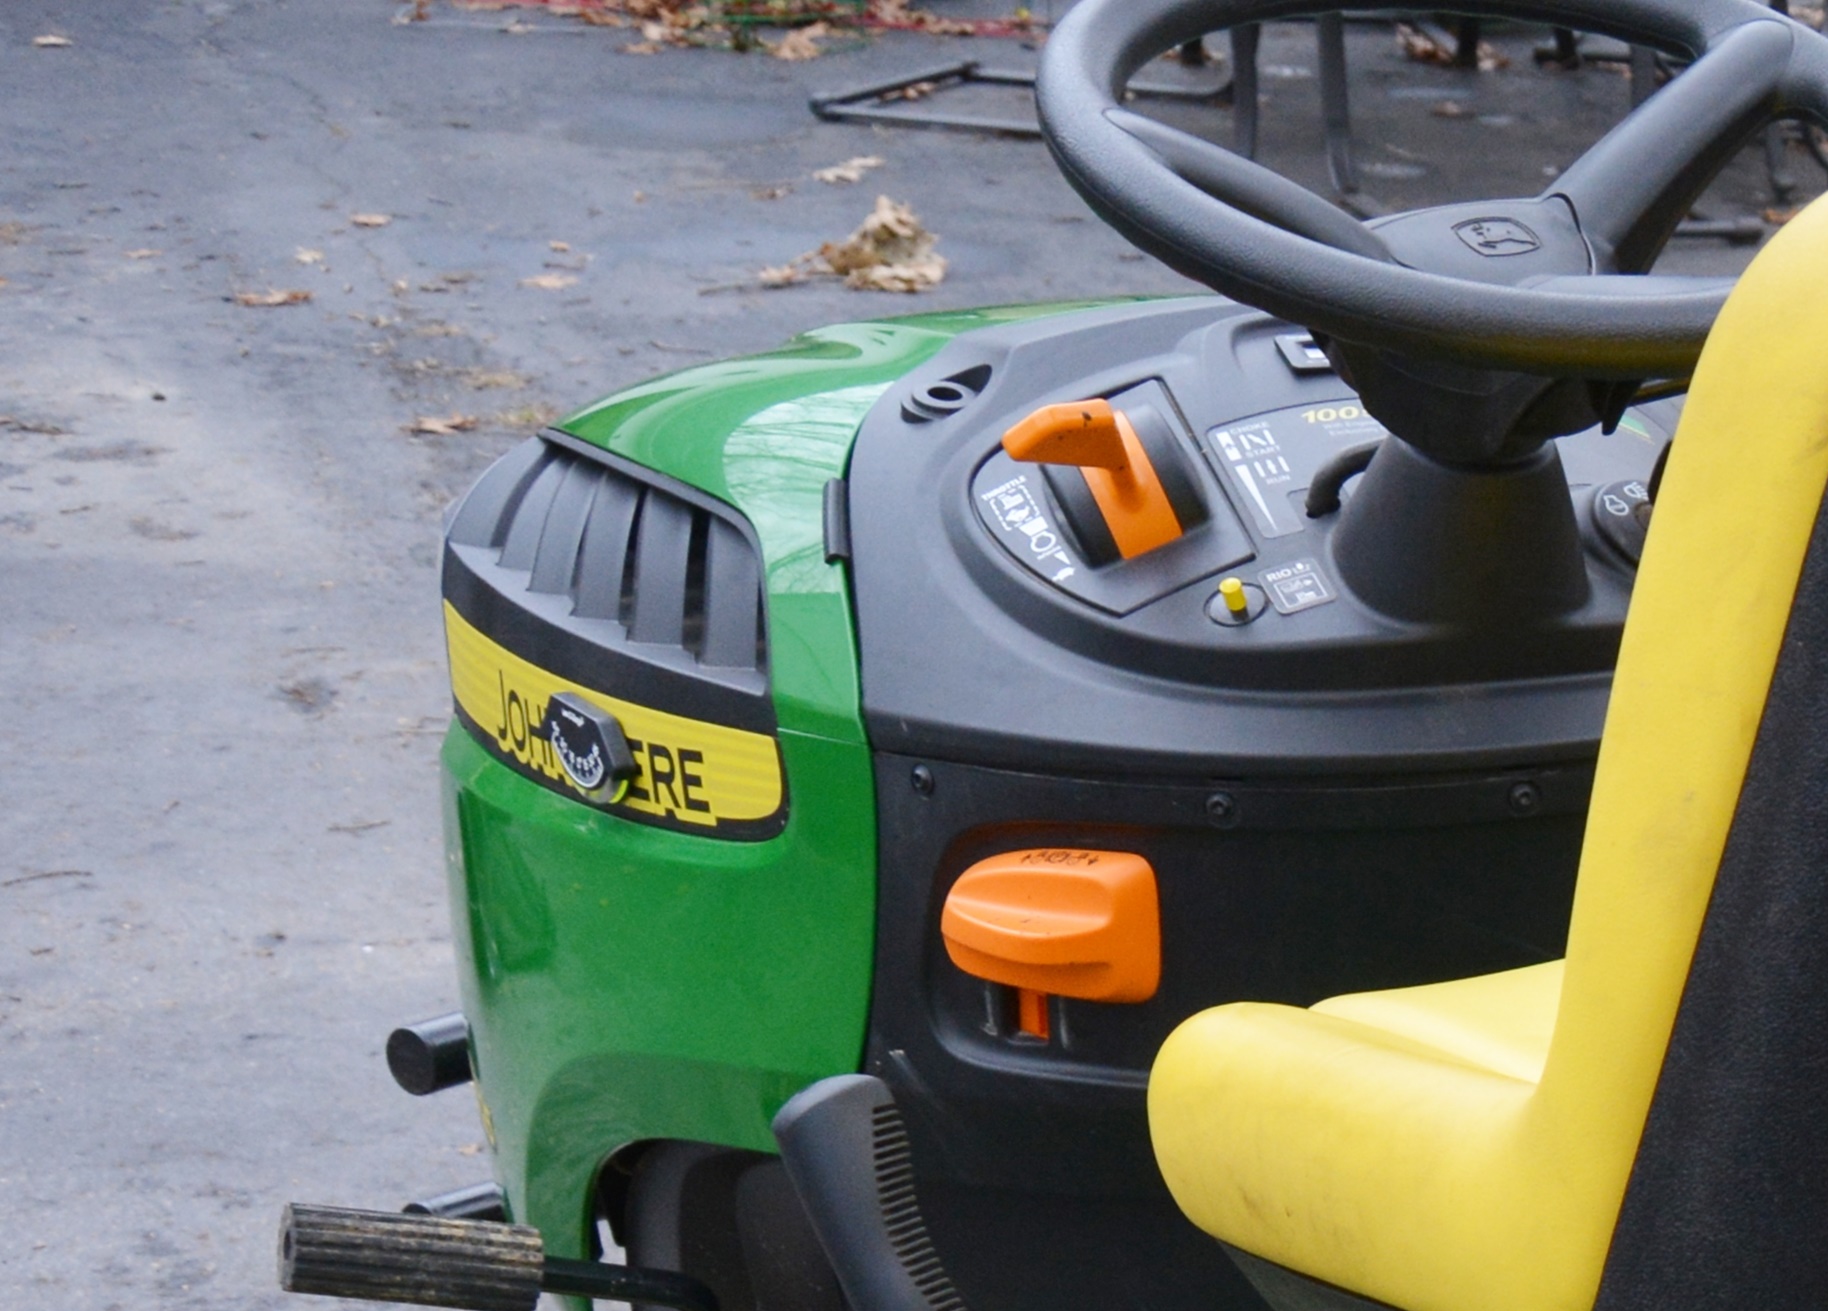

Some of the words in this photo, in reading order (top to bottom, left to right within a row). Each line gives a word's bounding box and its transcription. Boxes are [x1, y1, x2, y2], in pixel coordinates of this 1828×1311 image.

[1246, 444, 1281, 458] START
[1265, 566, 1292, 583] RIO
[497, 669, 557, 769] JOH
